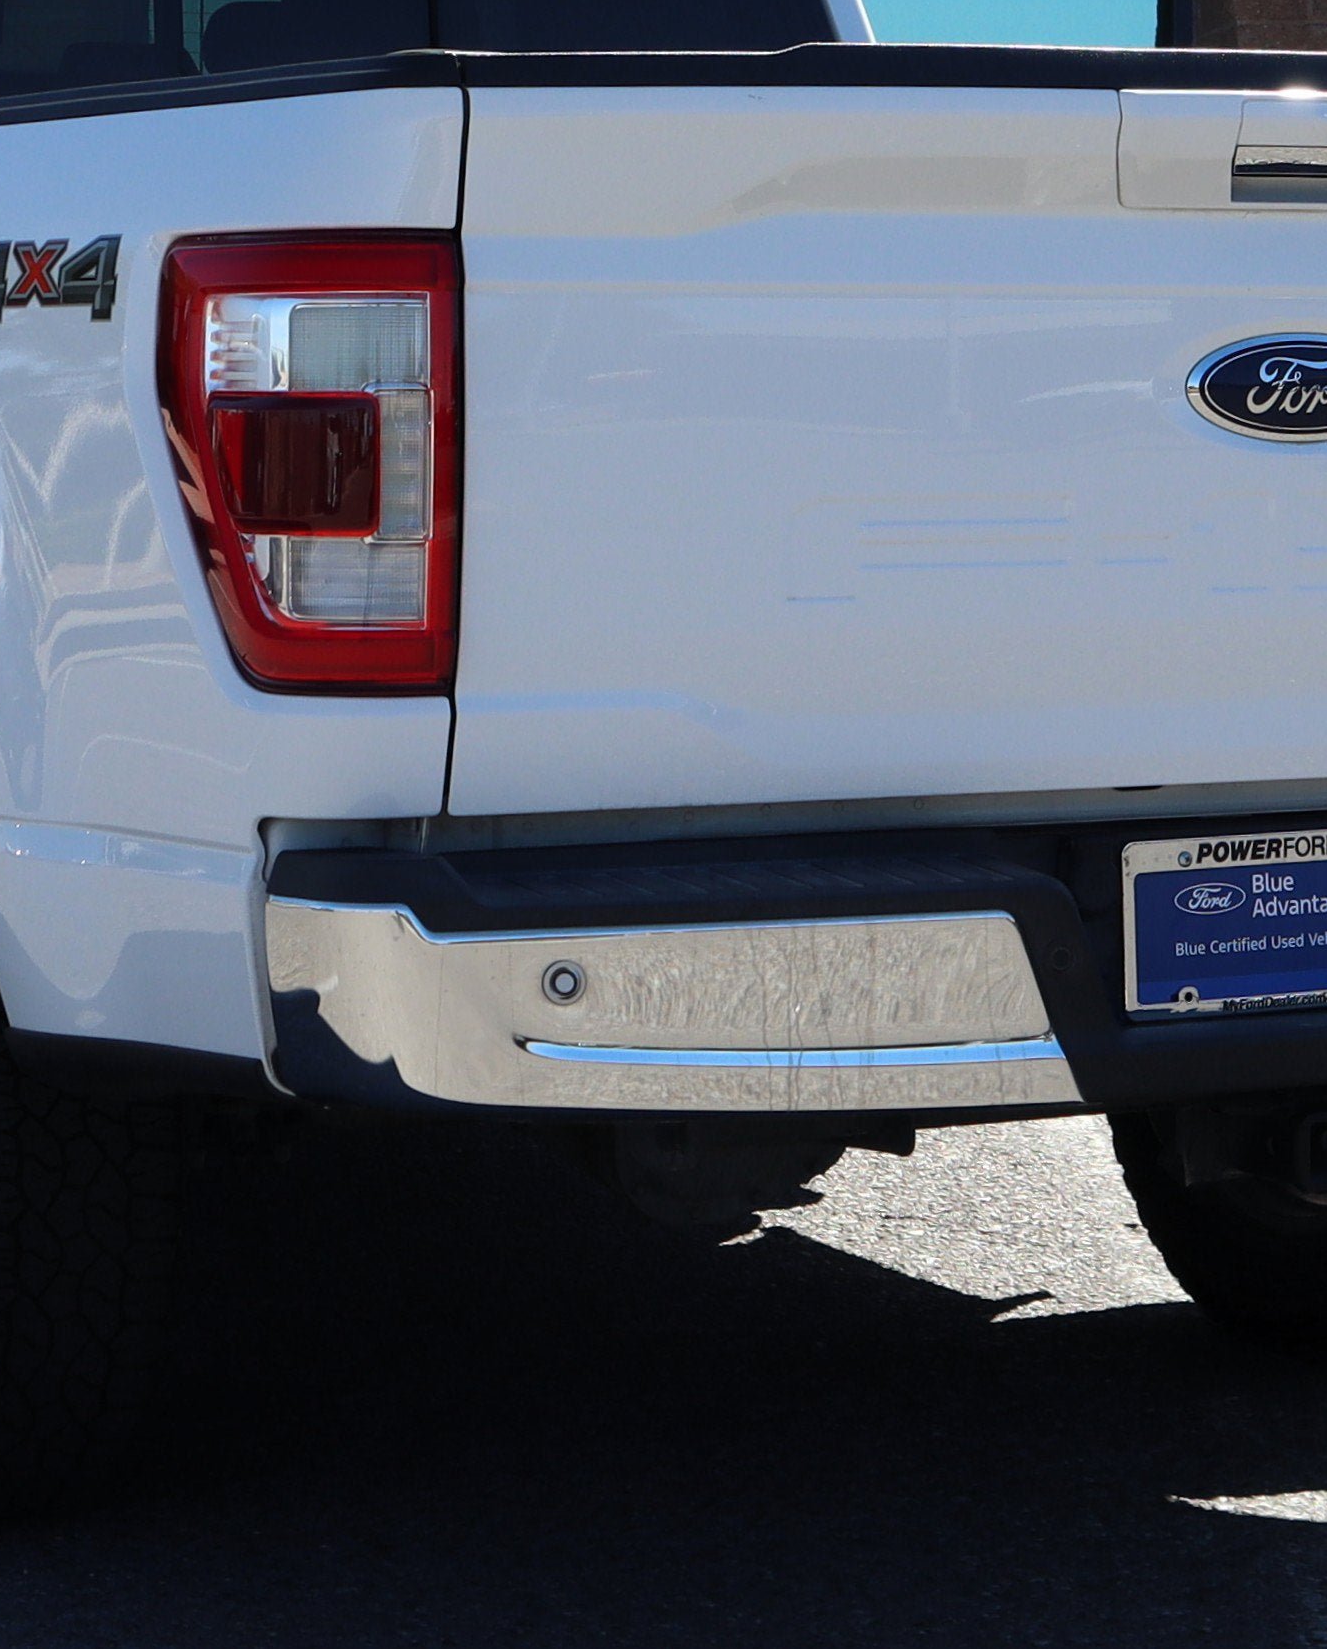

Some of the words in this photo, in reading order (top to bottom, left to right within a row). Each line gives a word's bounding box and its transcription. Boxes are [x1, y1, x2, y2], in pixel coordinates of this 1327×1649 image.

[1251, 873, 1295, 894] Blue
[1188, 887, 1233, 910] Ford
[1175, 941, 1206, 957] Blue
[1209, 936, 1267, 954] Certified
[1270, 933, 1305, 950] Used
